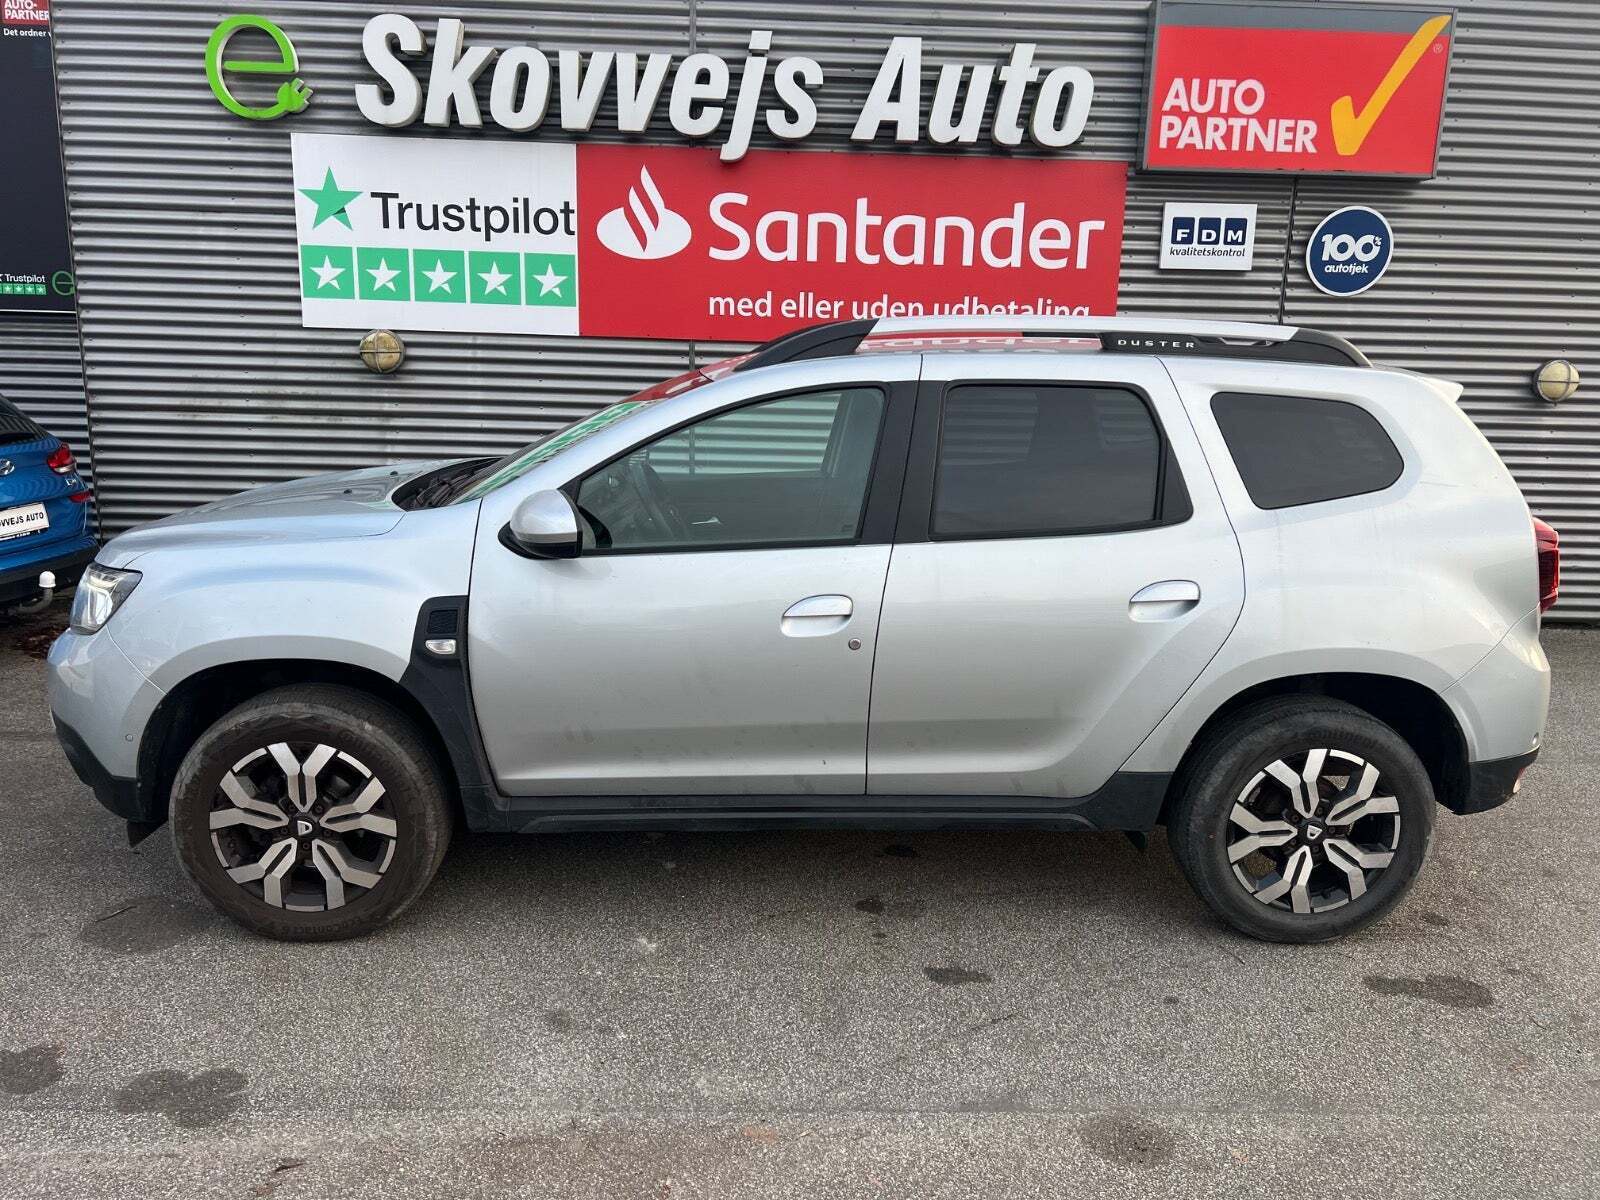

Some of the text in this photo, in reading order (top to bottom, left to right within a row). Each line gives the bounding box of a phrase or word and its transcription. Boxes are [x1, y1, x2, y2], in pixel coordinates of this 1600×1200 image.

[4, 9, 49, 21] PARTNER
[3, 28, 18, 36] Det
[19, 28, 46, 37] ordner
[355, 13, 1095, 162] Skovvejs Auto
[1161, 78, 1265, 116] AUTO
[1158, 115, 1318, 154] PARTNER
[370, 191, 576, 242] Trustpilot
[708, 192, 1105, 270] Santander
[1169, 246, 1246, 258] kvalitetskontrol
[1324, 263, 1369, 275] autotjek
[4, 273, 46, 283] Trustpilot
[708, 291, 773, 317] med
[781, 292, 844, 319] eller
[852, 295, 925, 319] uden
[1116, 338, 1196, 349] DUSTER
[0, 511, 44, 527] VVEJS AUTO
